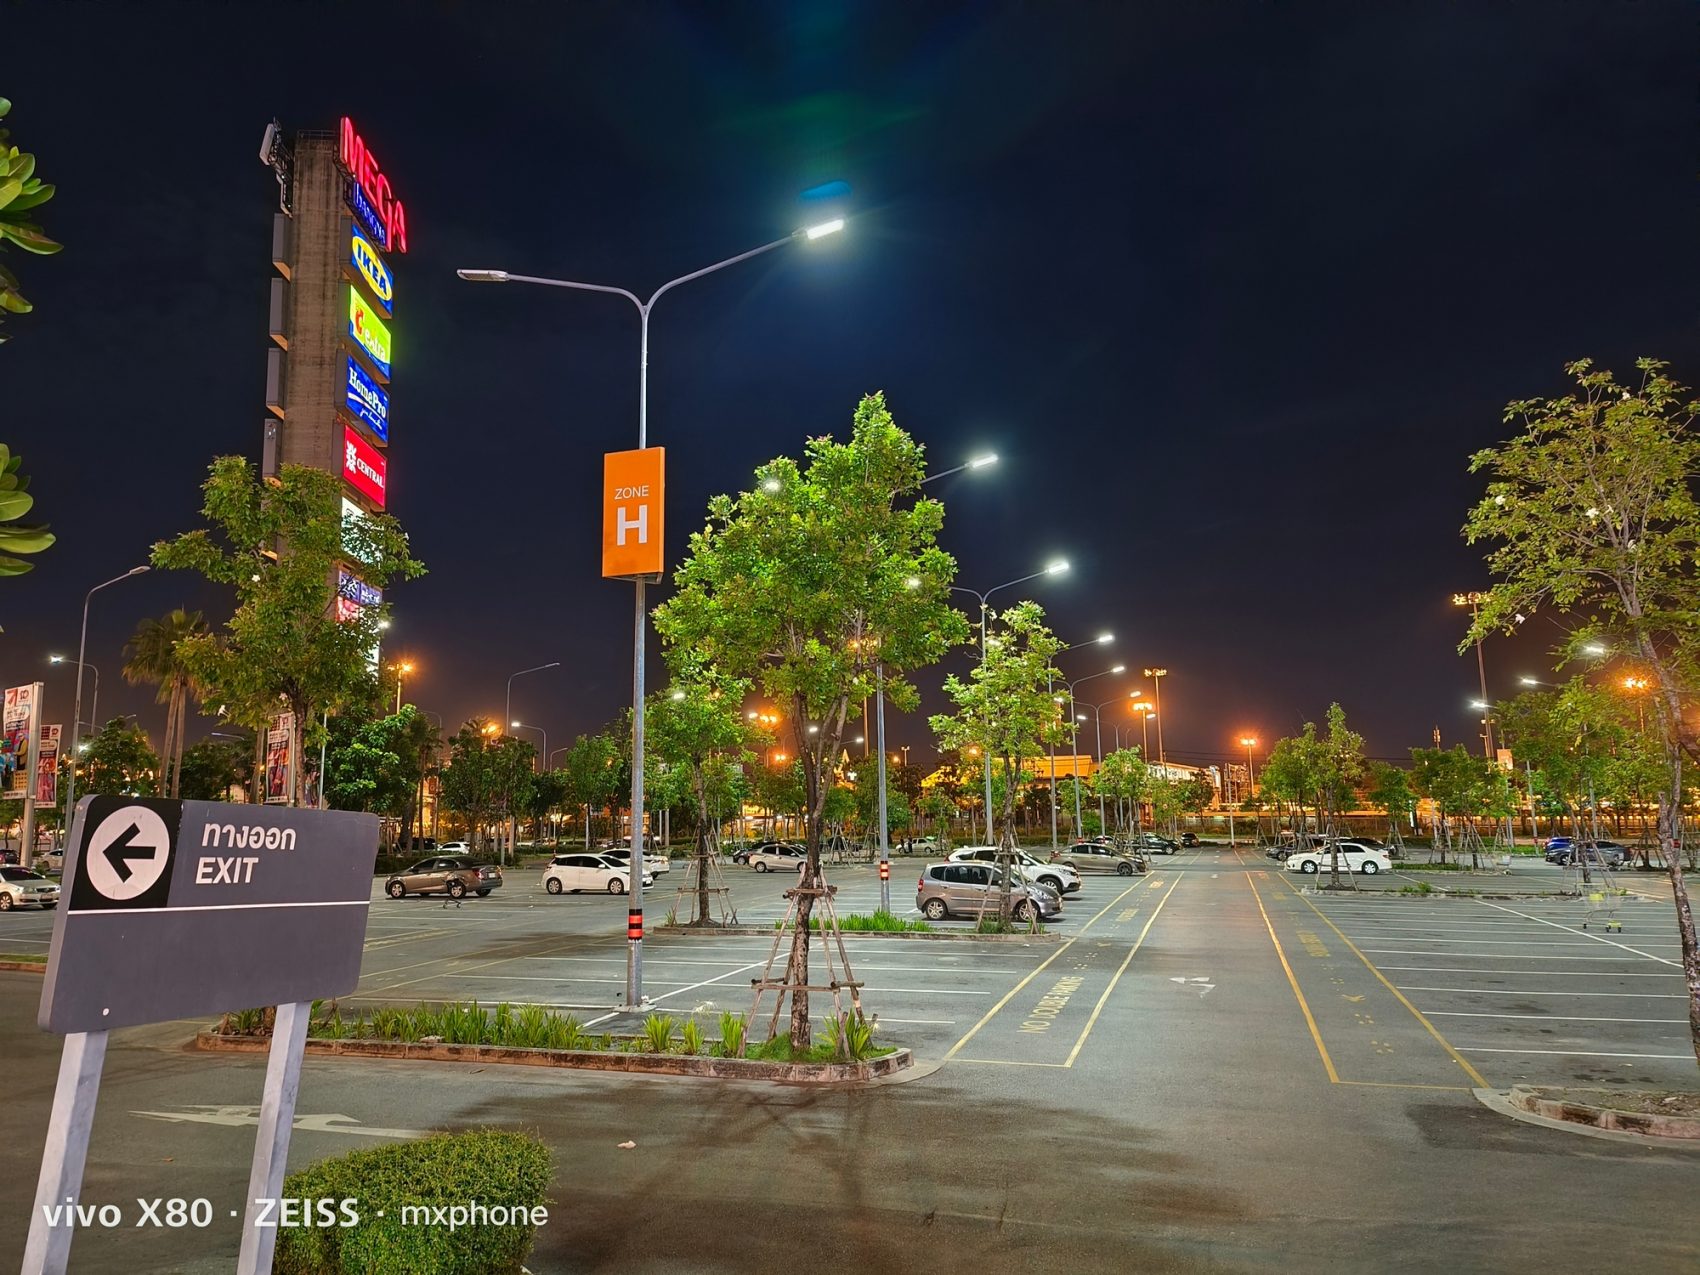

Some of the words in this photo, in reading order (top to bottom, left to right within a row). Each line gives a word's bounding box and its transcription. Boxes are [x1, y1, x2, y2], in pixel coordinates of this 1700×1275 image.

[342, 117, 407, 252] MEGA
[357, 242, 388, 295] IKEA
[349, 366, 386, 418] HomePro
[356, 457, 384, 489] CENTRAL
[614, 485, 650, 500] ZONE
[617, 504, 648, 546] H
[202, 823, 297, 850] ทางออก
[196, 857, 259, 884] EXIT
[1016, 1020, 1051, 1034] NO
